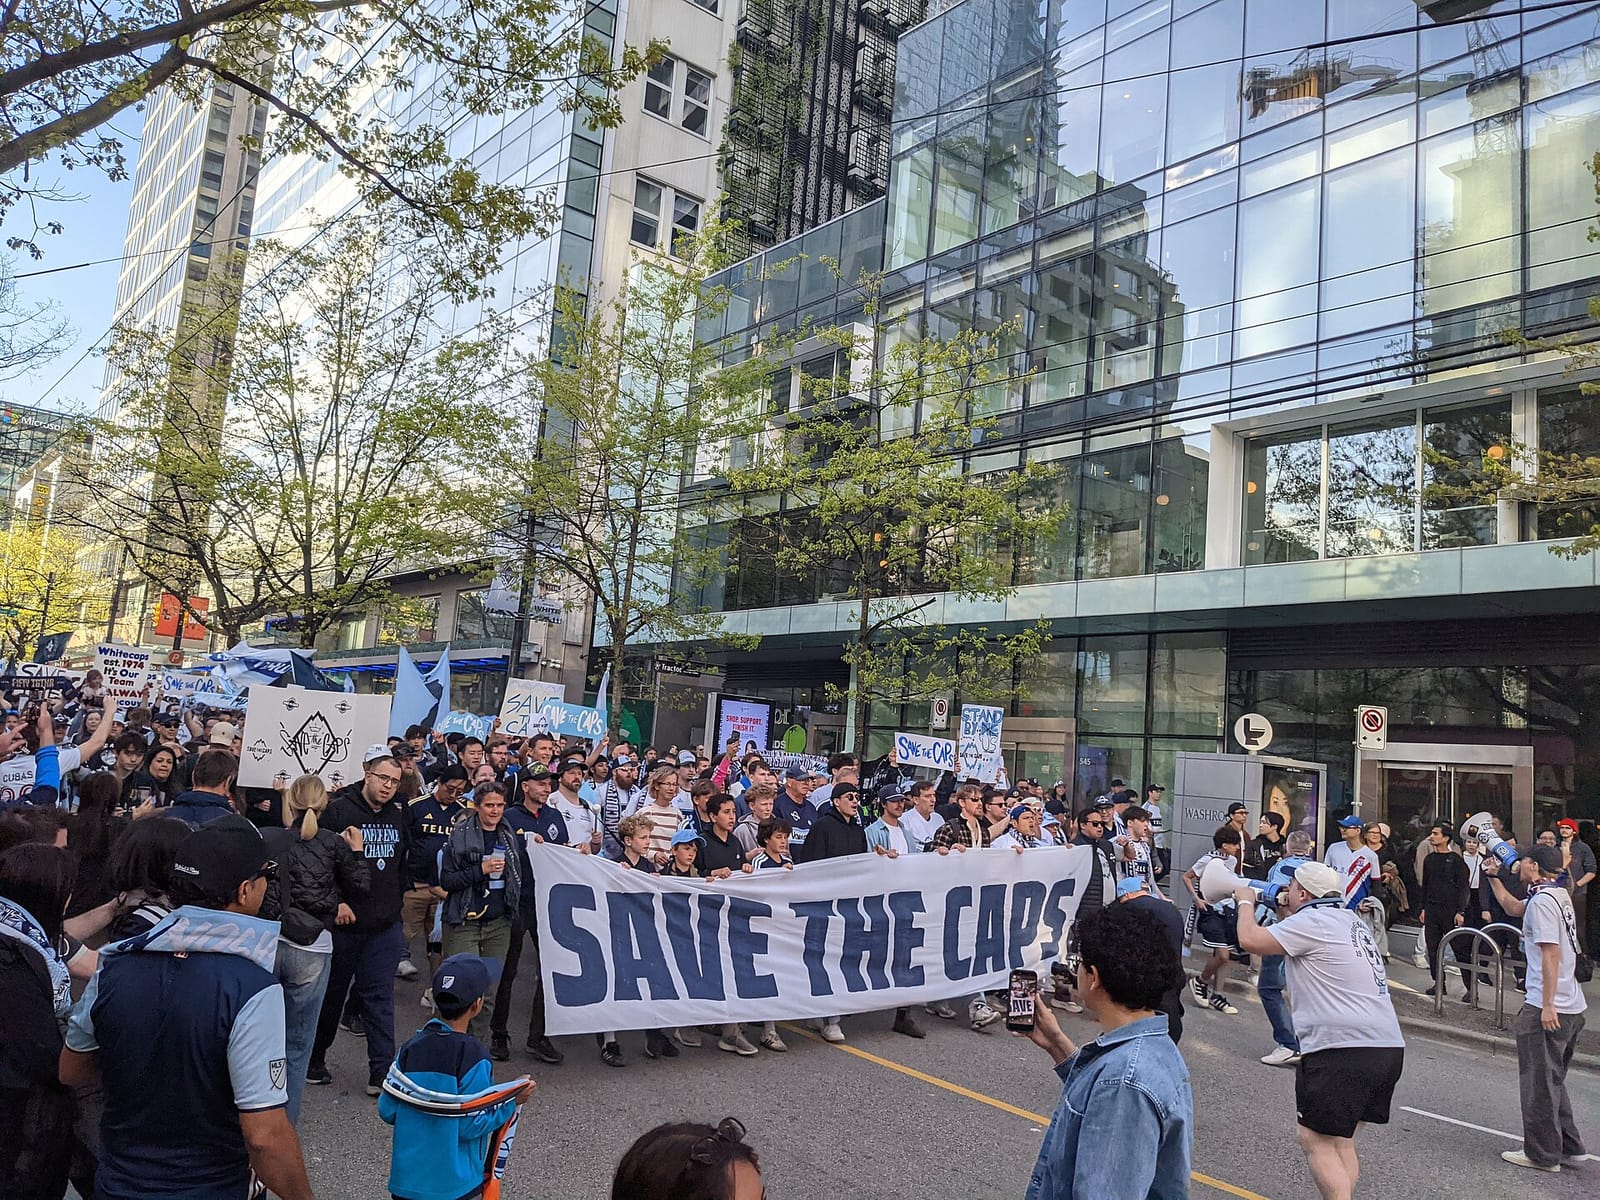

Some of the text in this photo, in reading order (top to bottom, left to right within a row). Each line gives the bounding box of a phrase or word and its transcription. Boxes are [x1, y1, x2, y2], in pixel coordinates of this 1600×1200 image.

[98, 646, 149, 661] Whitecaps
[104, 659, 145, 670] est. 1974
[661, 663, 682, 673] Tractor
[104, 667, 117, 676] It's
[119, 669, 139, 679] Our
[109, 677, 135, 687] Team
[962, 707, 1003, 724] STAND
[577, 711, 603, 735] CAPS
[963, 721, 978, 735] BY
[898, 736, 954, 767] SAVE THE CAPS
[1080, 758, 1091, 766] 545
[3, 770, 33, 783] CUBAS
[1185, 807, 1230, 822] WASHRO
[361, 828, 400, 842] ONFERENCE
[422, 824, 453, 835] TELU
[365, 844, 395, 858] CHAMPS
[548, 878, 1076, 1007] SAVE THE CAPS
